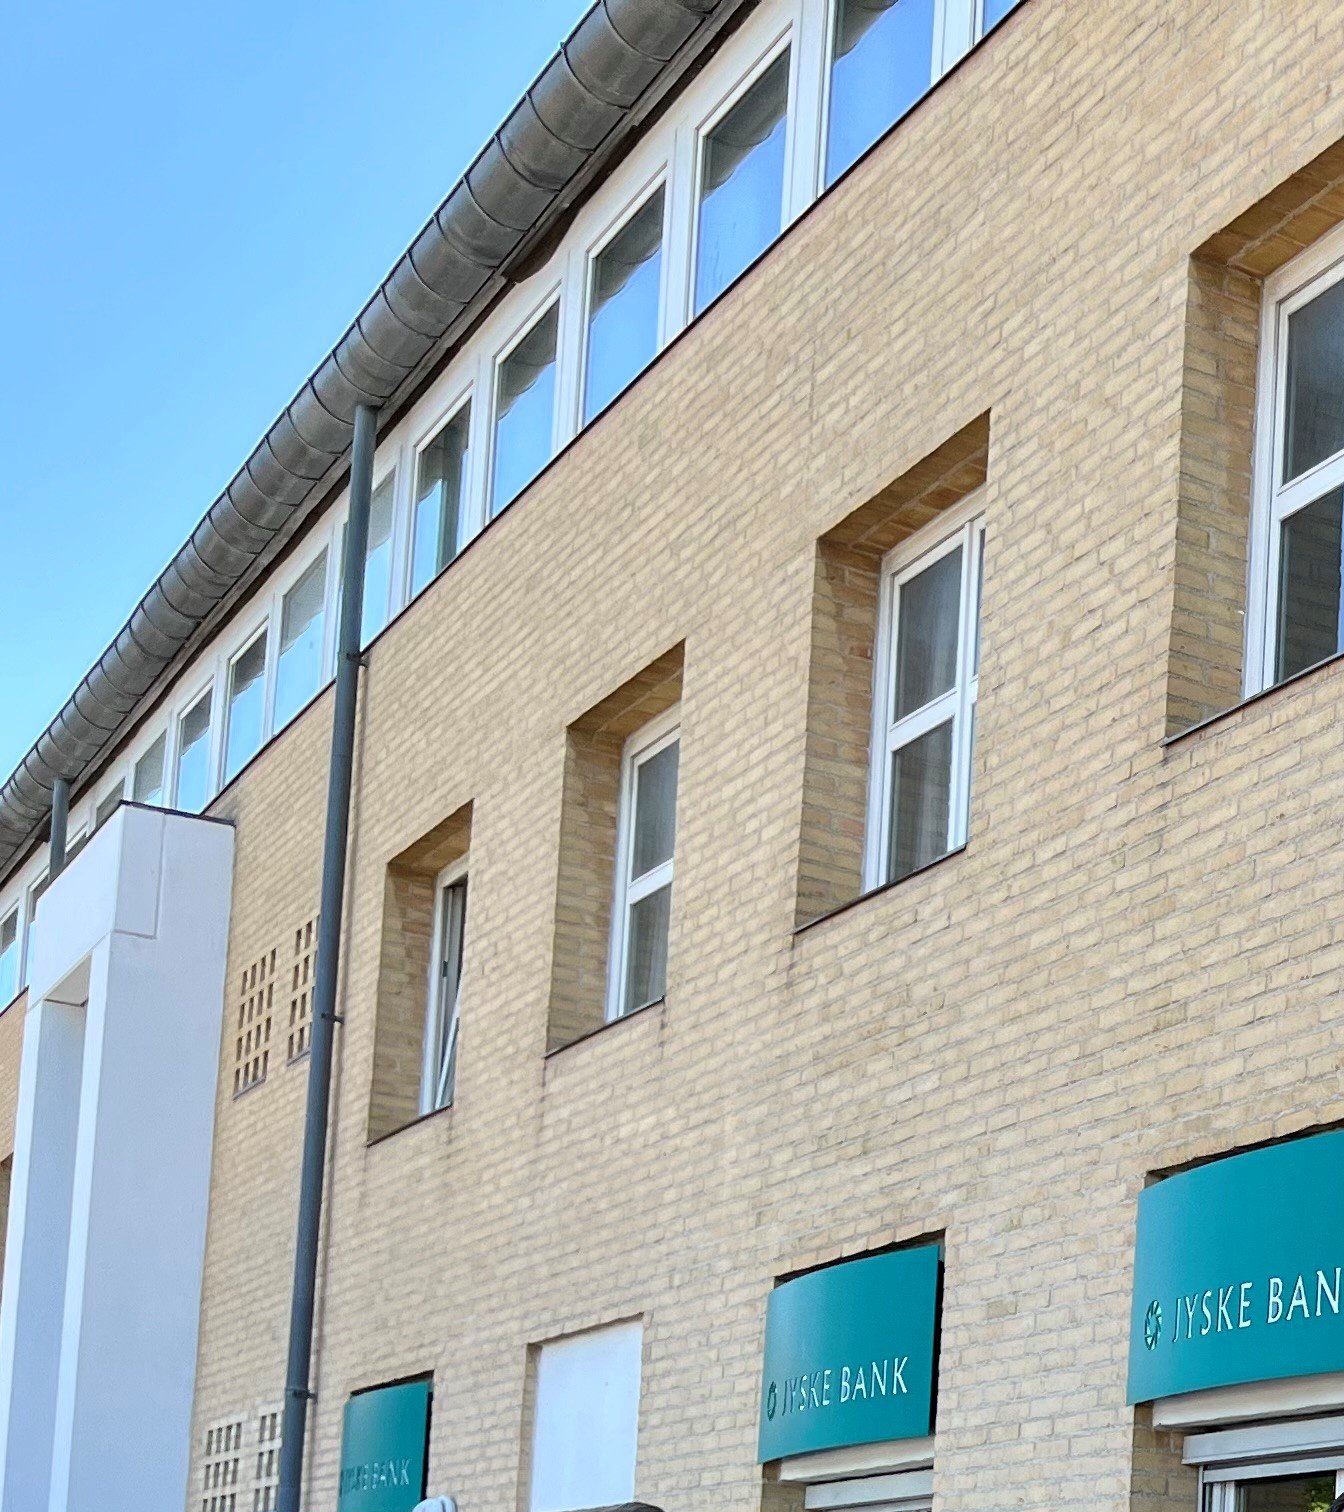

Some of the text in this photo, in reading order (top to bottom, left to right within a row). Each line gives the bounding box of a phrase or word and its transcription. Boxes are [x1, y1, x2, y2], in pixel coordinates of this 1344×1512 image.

[1172, 1282, 1253, 1343] JYSKE
[782, 1356, 908, 1417] JYSKE BANK
